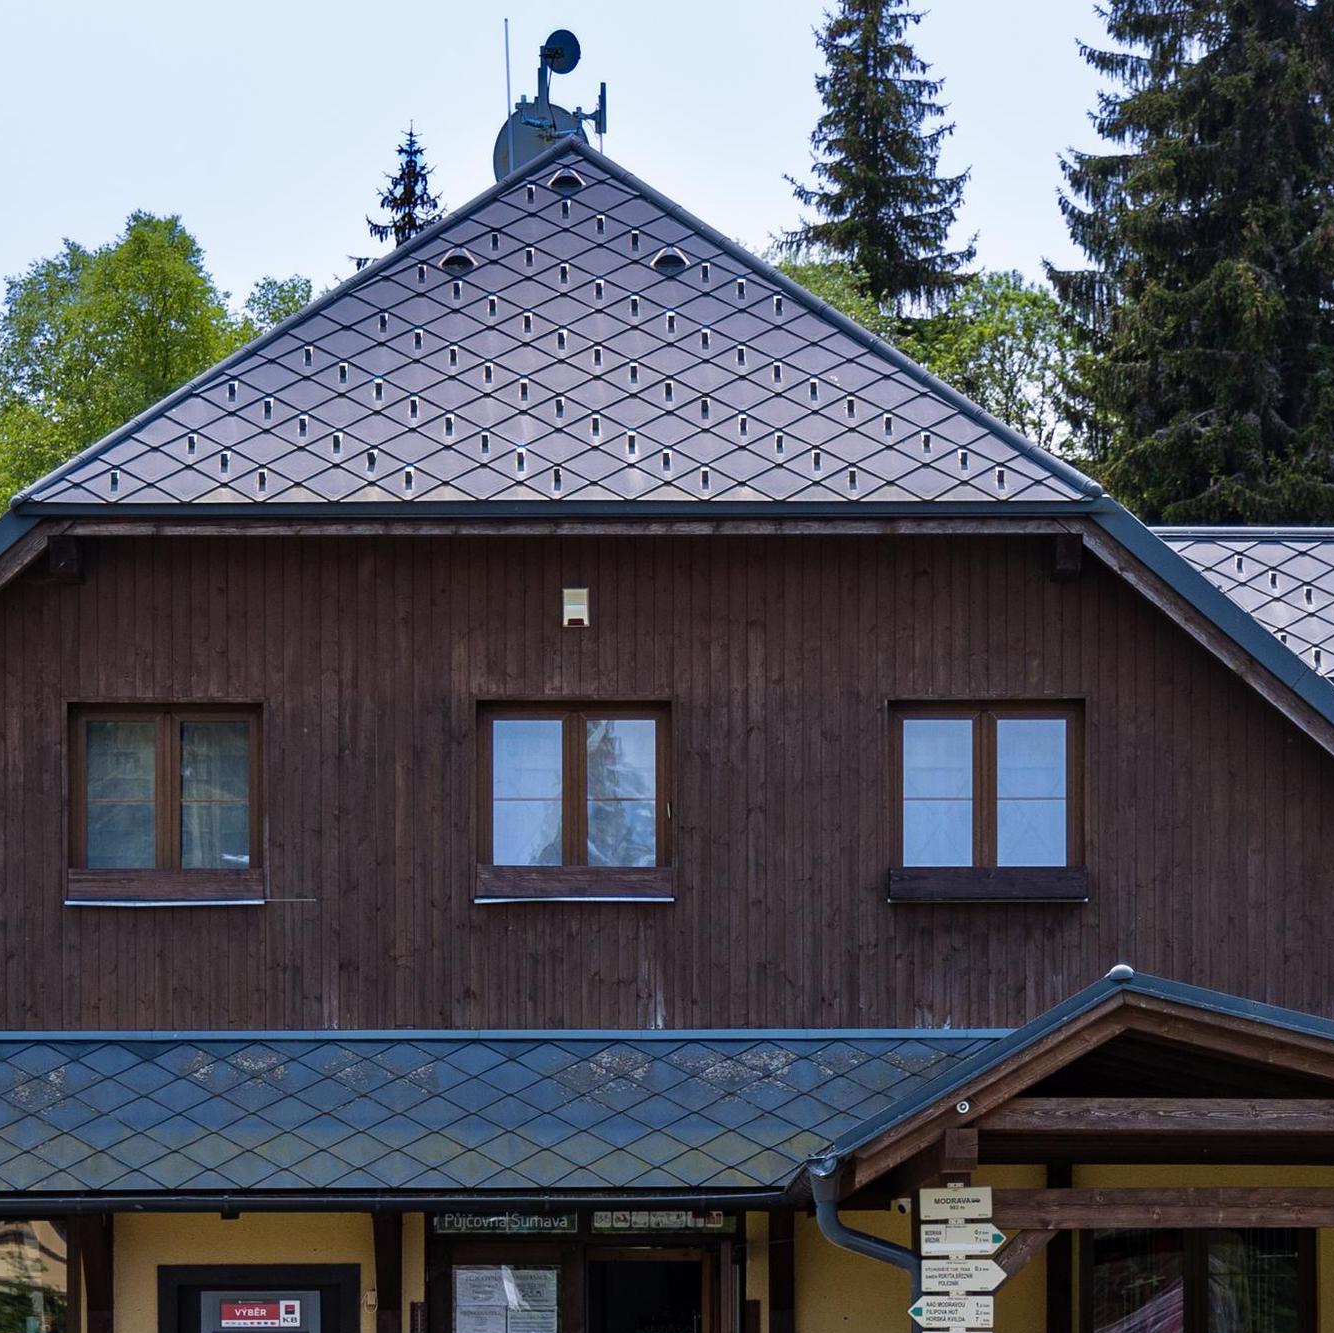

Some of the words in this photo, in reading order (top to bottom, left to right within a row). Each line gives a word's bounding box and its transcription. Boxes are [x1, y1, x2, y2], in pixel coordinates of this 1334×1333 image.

[445, 1212, 506, 1231] Půjčovna
[511, 1211, 568, 1228] Šumava
[234, 1307, 267, 1316] VÝBĚR
